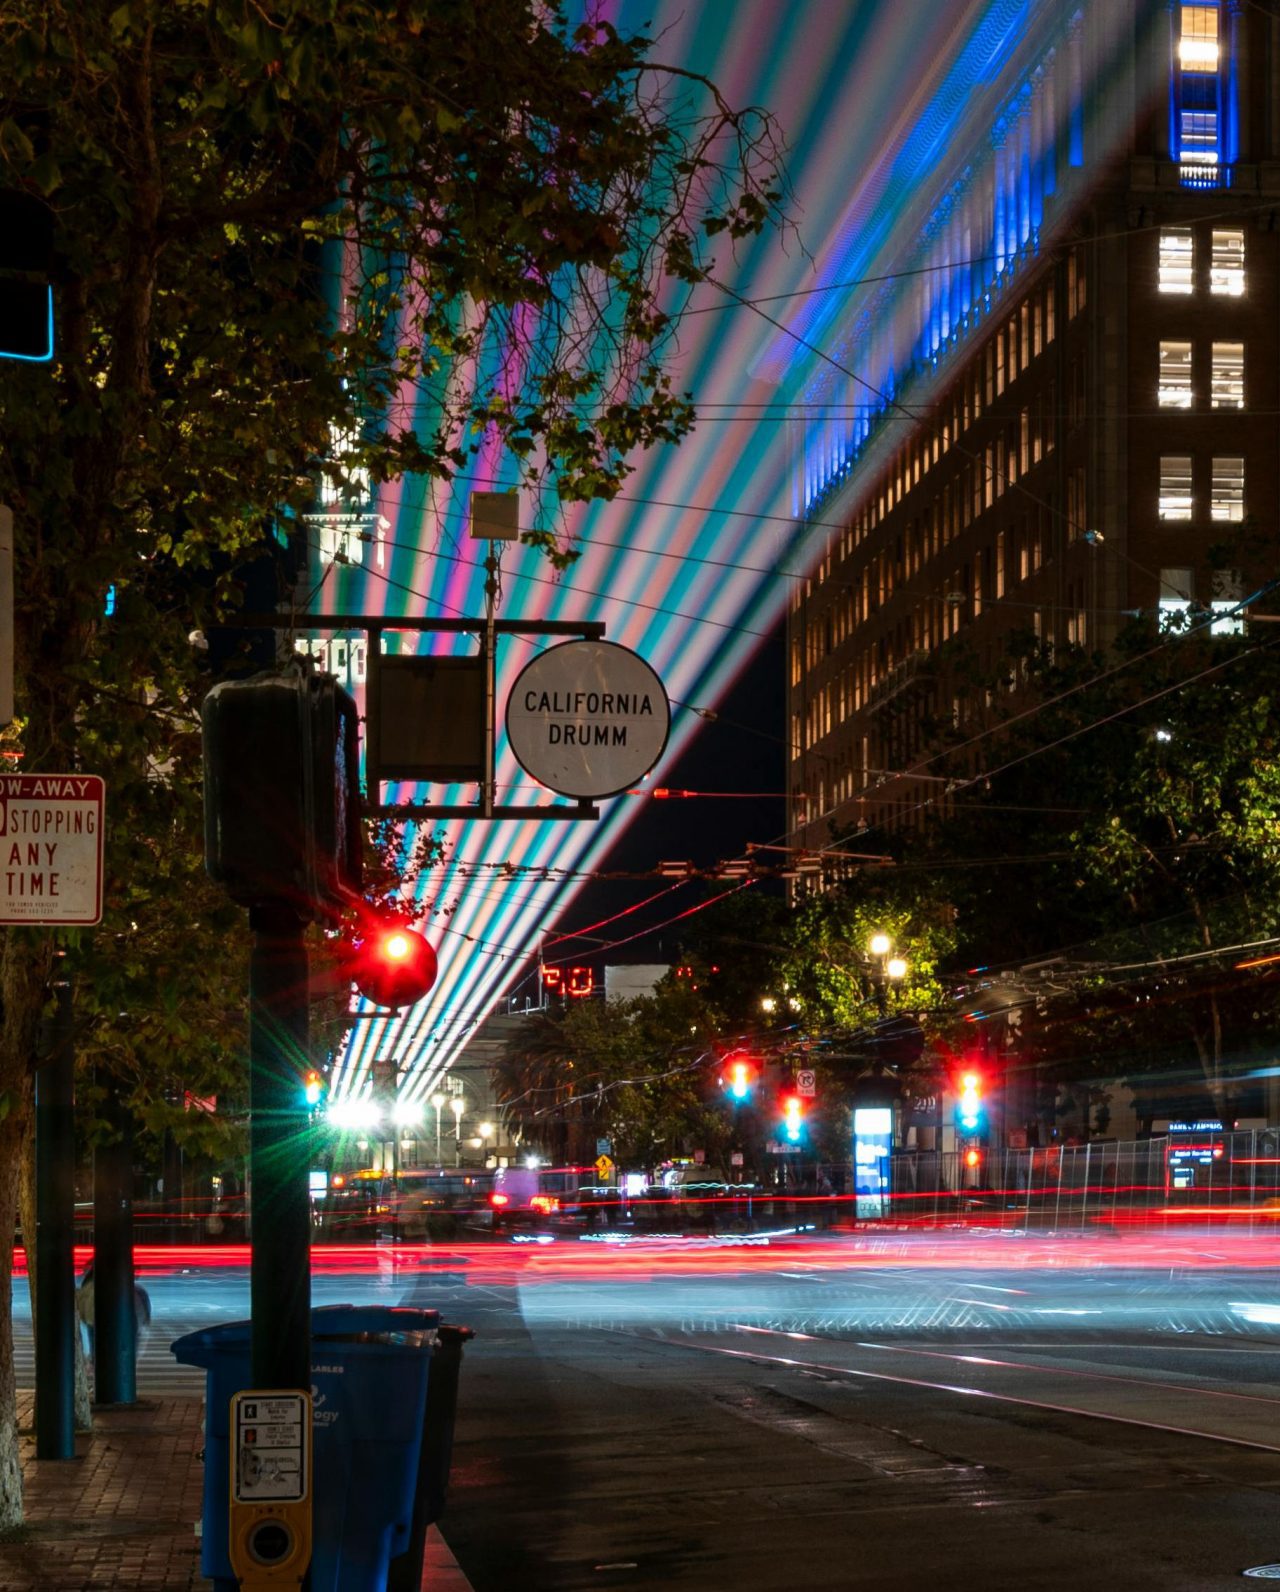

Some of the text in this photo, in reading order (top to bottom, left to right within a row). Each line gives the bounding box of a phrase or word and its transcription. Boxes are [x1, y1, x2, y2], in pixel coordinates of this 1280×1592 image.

[524, 691, 653, 716] CALIFORNIA
[549, 724, 627, 747] DRUMM
[0, 780, 89, 796] W-AWAY
[10, 809, 95, 834] STOPPING
[8, 842, 58, 866] ANY
[5, 872, 60, 897] TIME
[313, 1411, 339, 1422] ogy
